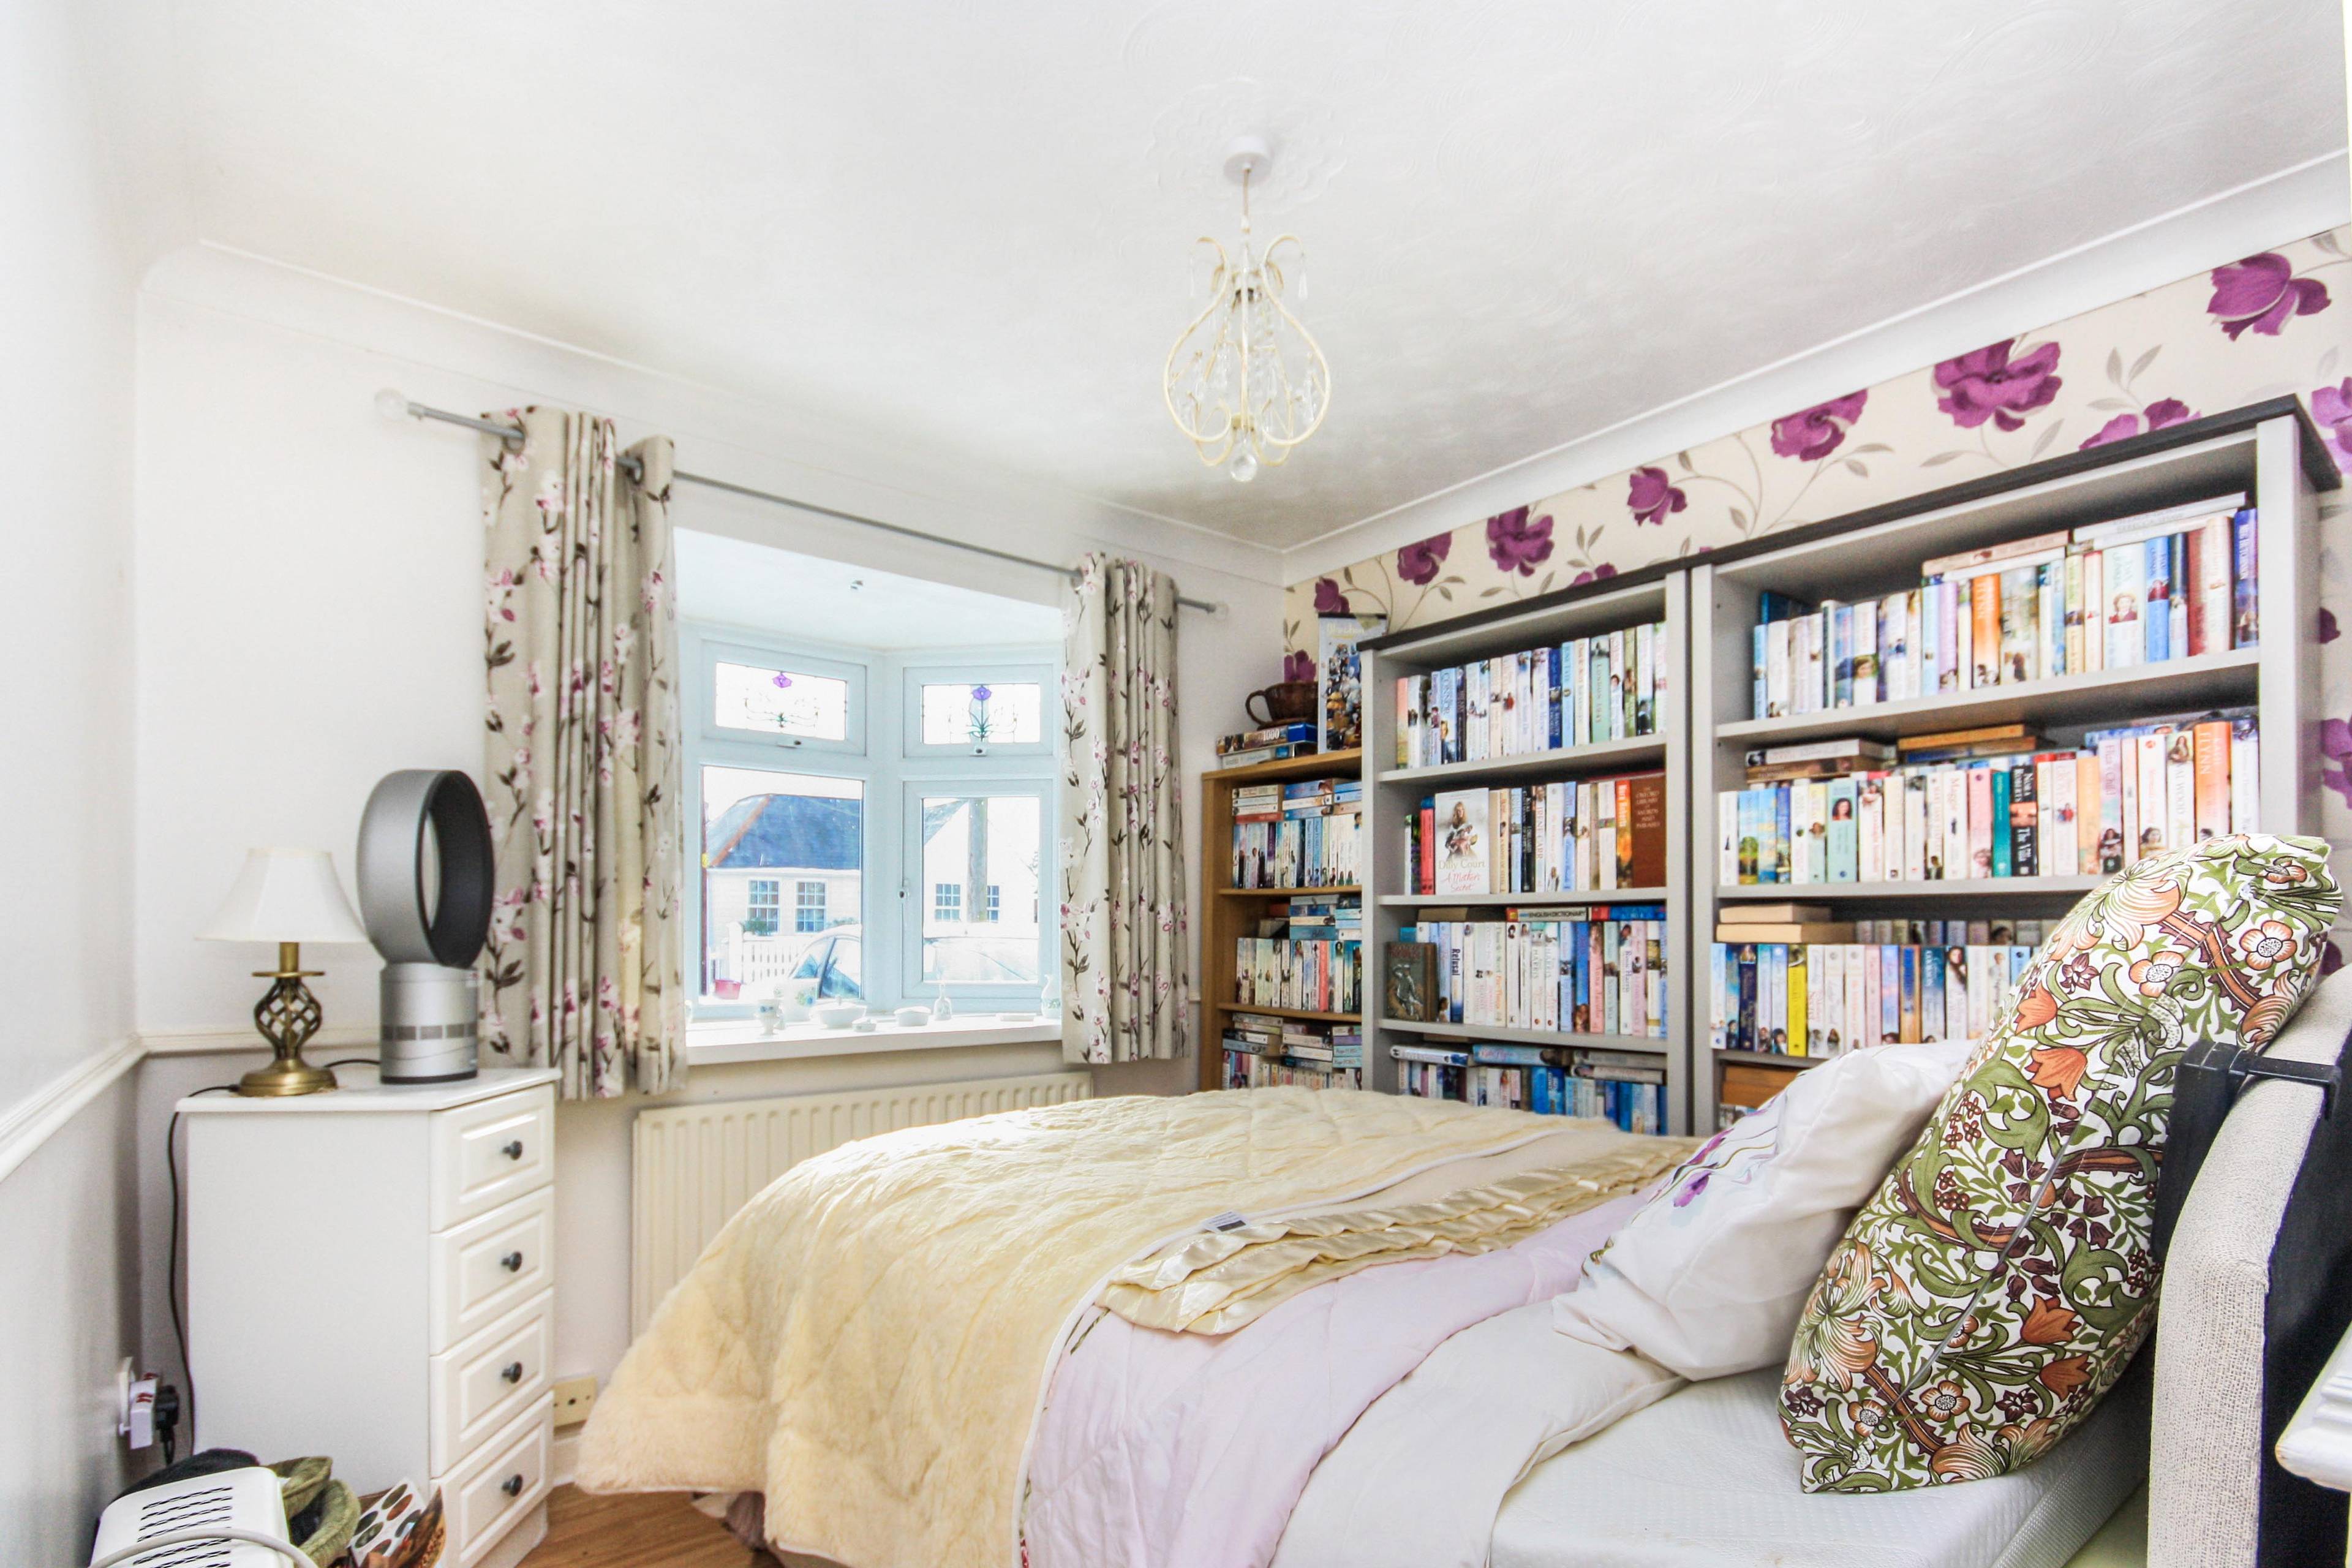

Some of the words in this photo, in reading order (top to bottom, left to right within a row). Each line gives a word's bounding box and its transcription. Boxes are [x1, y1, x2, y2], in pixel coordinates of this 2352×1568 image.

[1263, 729, 1280, 741] 1000
[1536, 835, 1544, 859] CARR
[1439, 860, 1458, 870] Dilly
[1460, 859, 1485, 869] Court
[1452, 949, 1461, 976] Refusal
